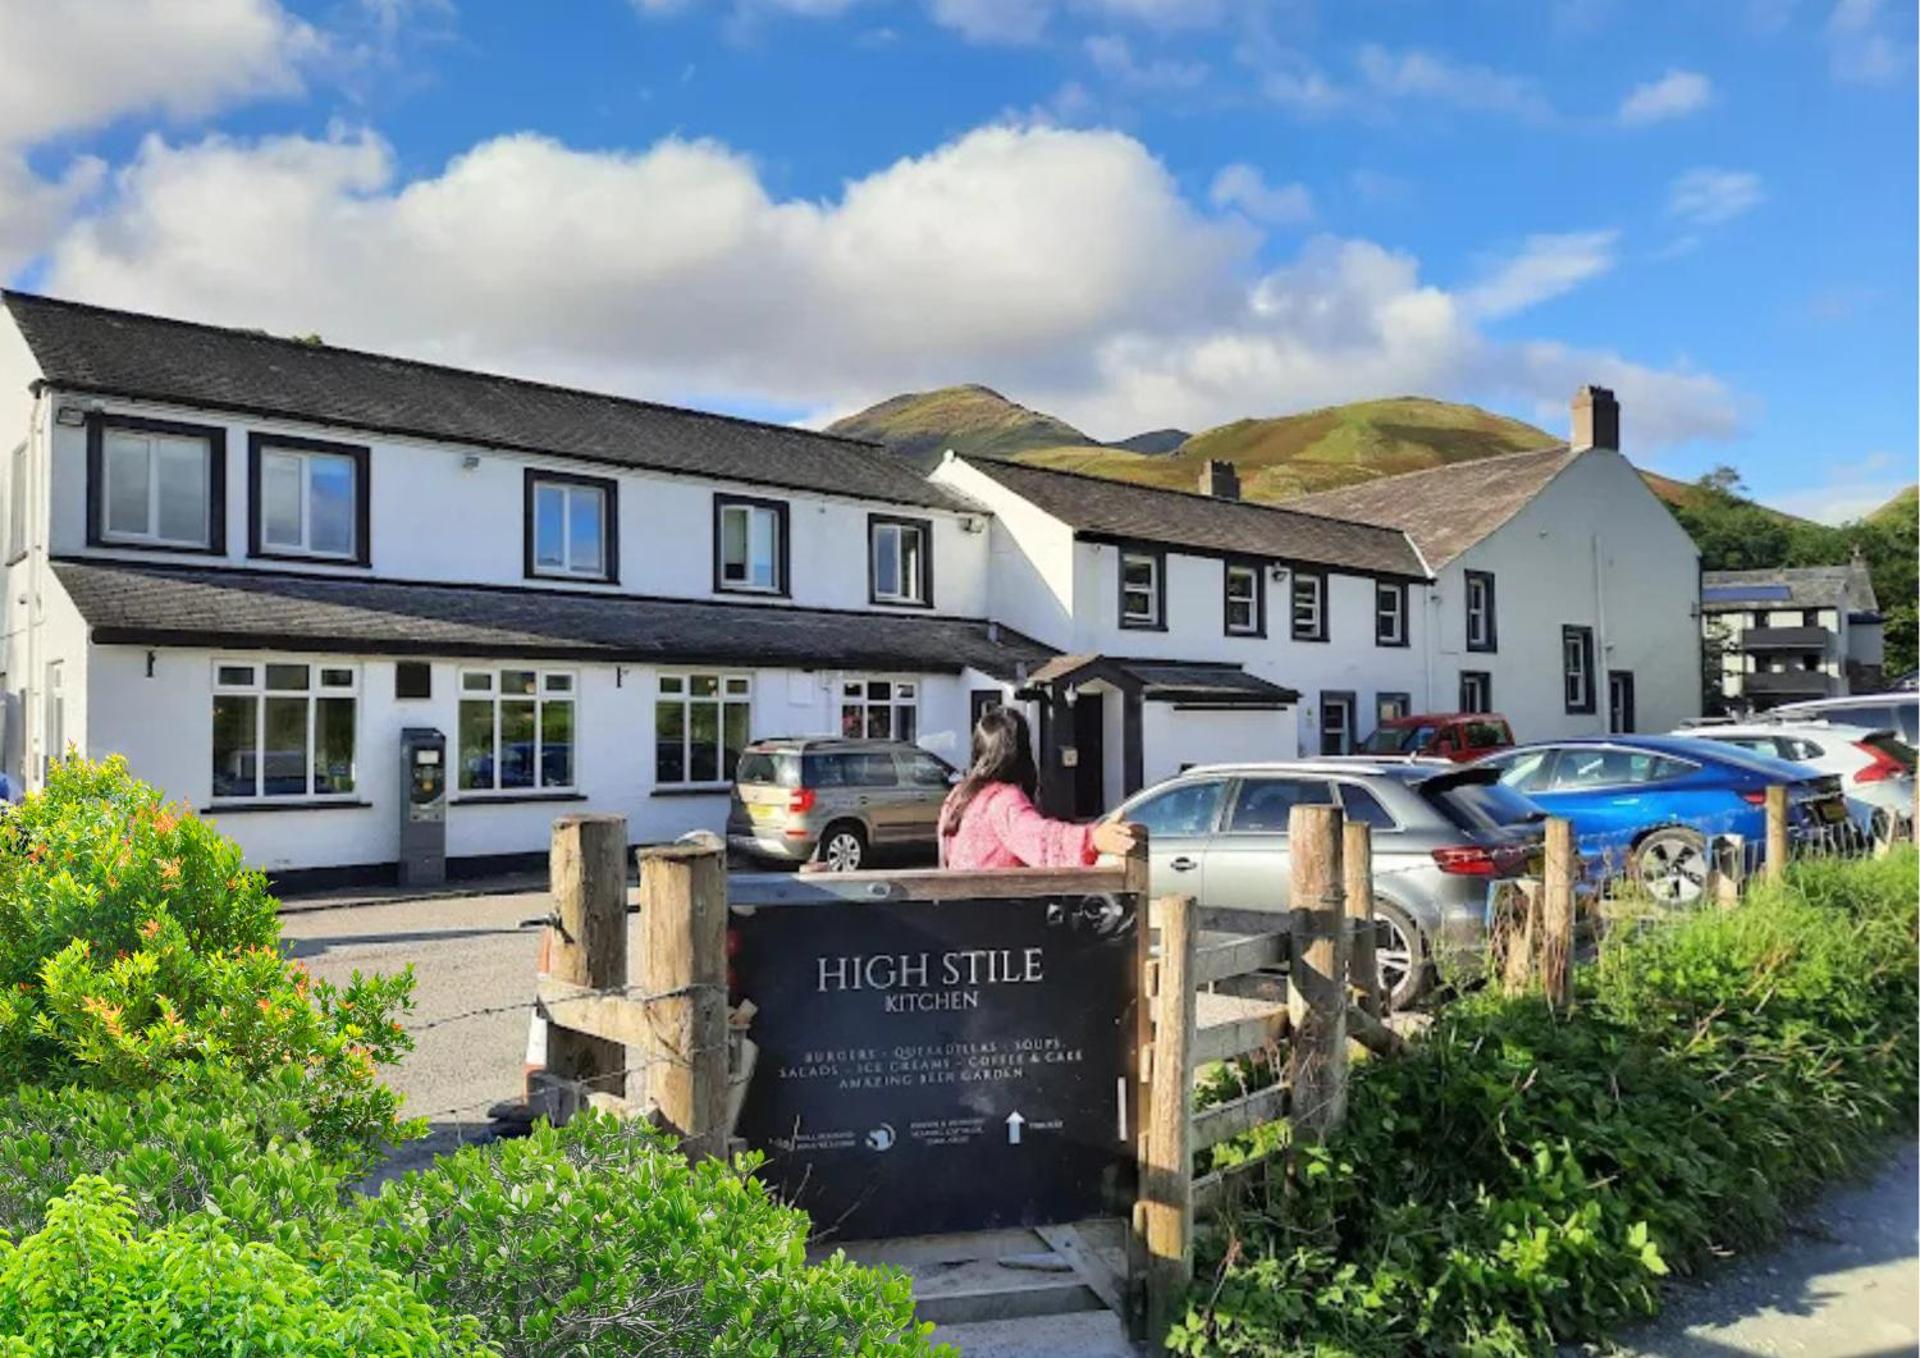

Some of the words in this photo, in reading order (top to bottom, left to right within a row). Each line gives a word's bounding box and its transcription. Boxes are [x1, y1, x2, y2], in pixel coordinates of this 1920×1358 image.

[817, 953, 929, 992] HIGH
[942, 948, 1044, 985] STILE
[885, 990, 980, 1013] KITCHEN
[779, 1064, 839, 1078] SALADS
[857, 1061, 884, 1074] ICE
[889, 1058, 950, 1073] CREAMS
[968, 1053, 1025, 1067] COFFEE
[805, 1049, 875, 1063] BURGERS
[840, 1074, 913, 1089] AMAZING
[960, 1067, 1023, 1081] GARDEN
